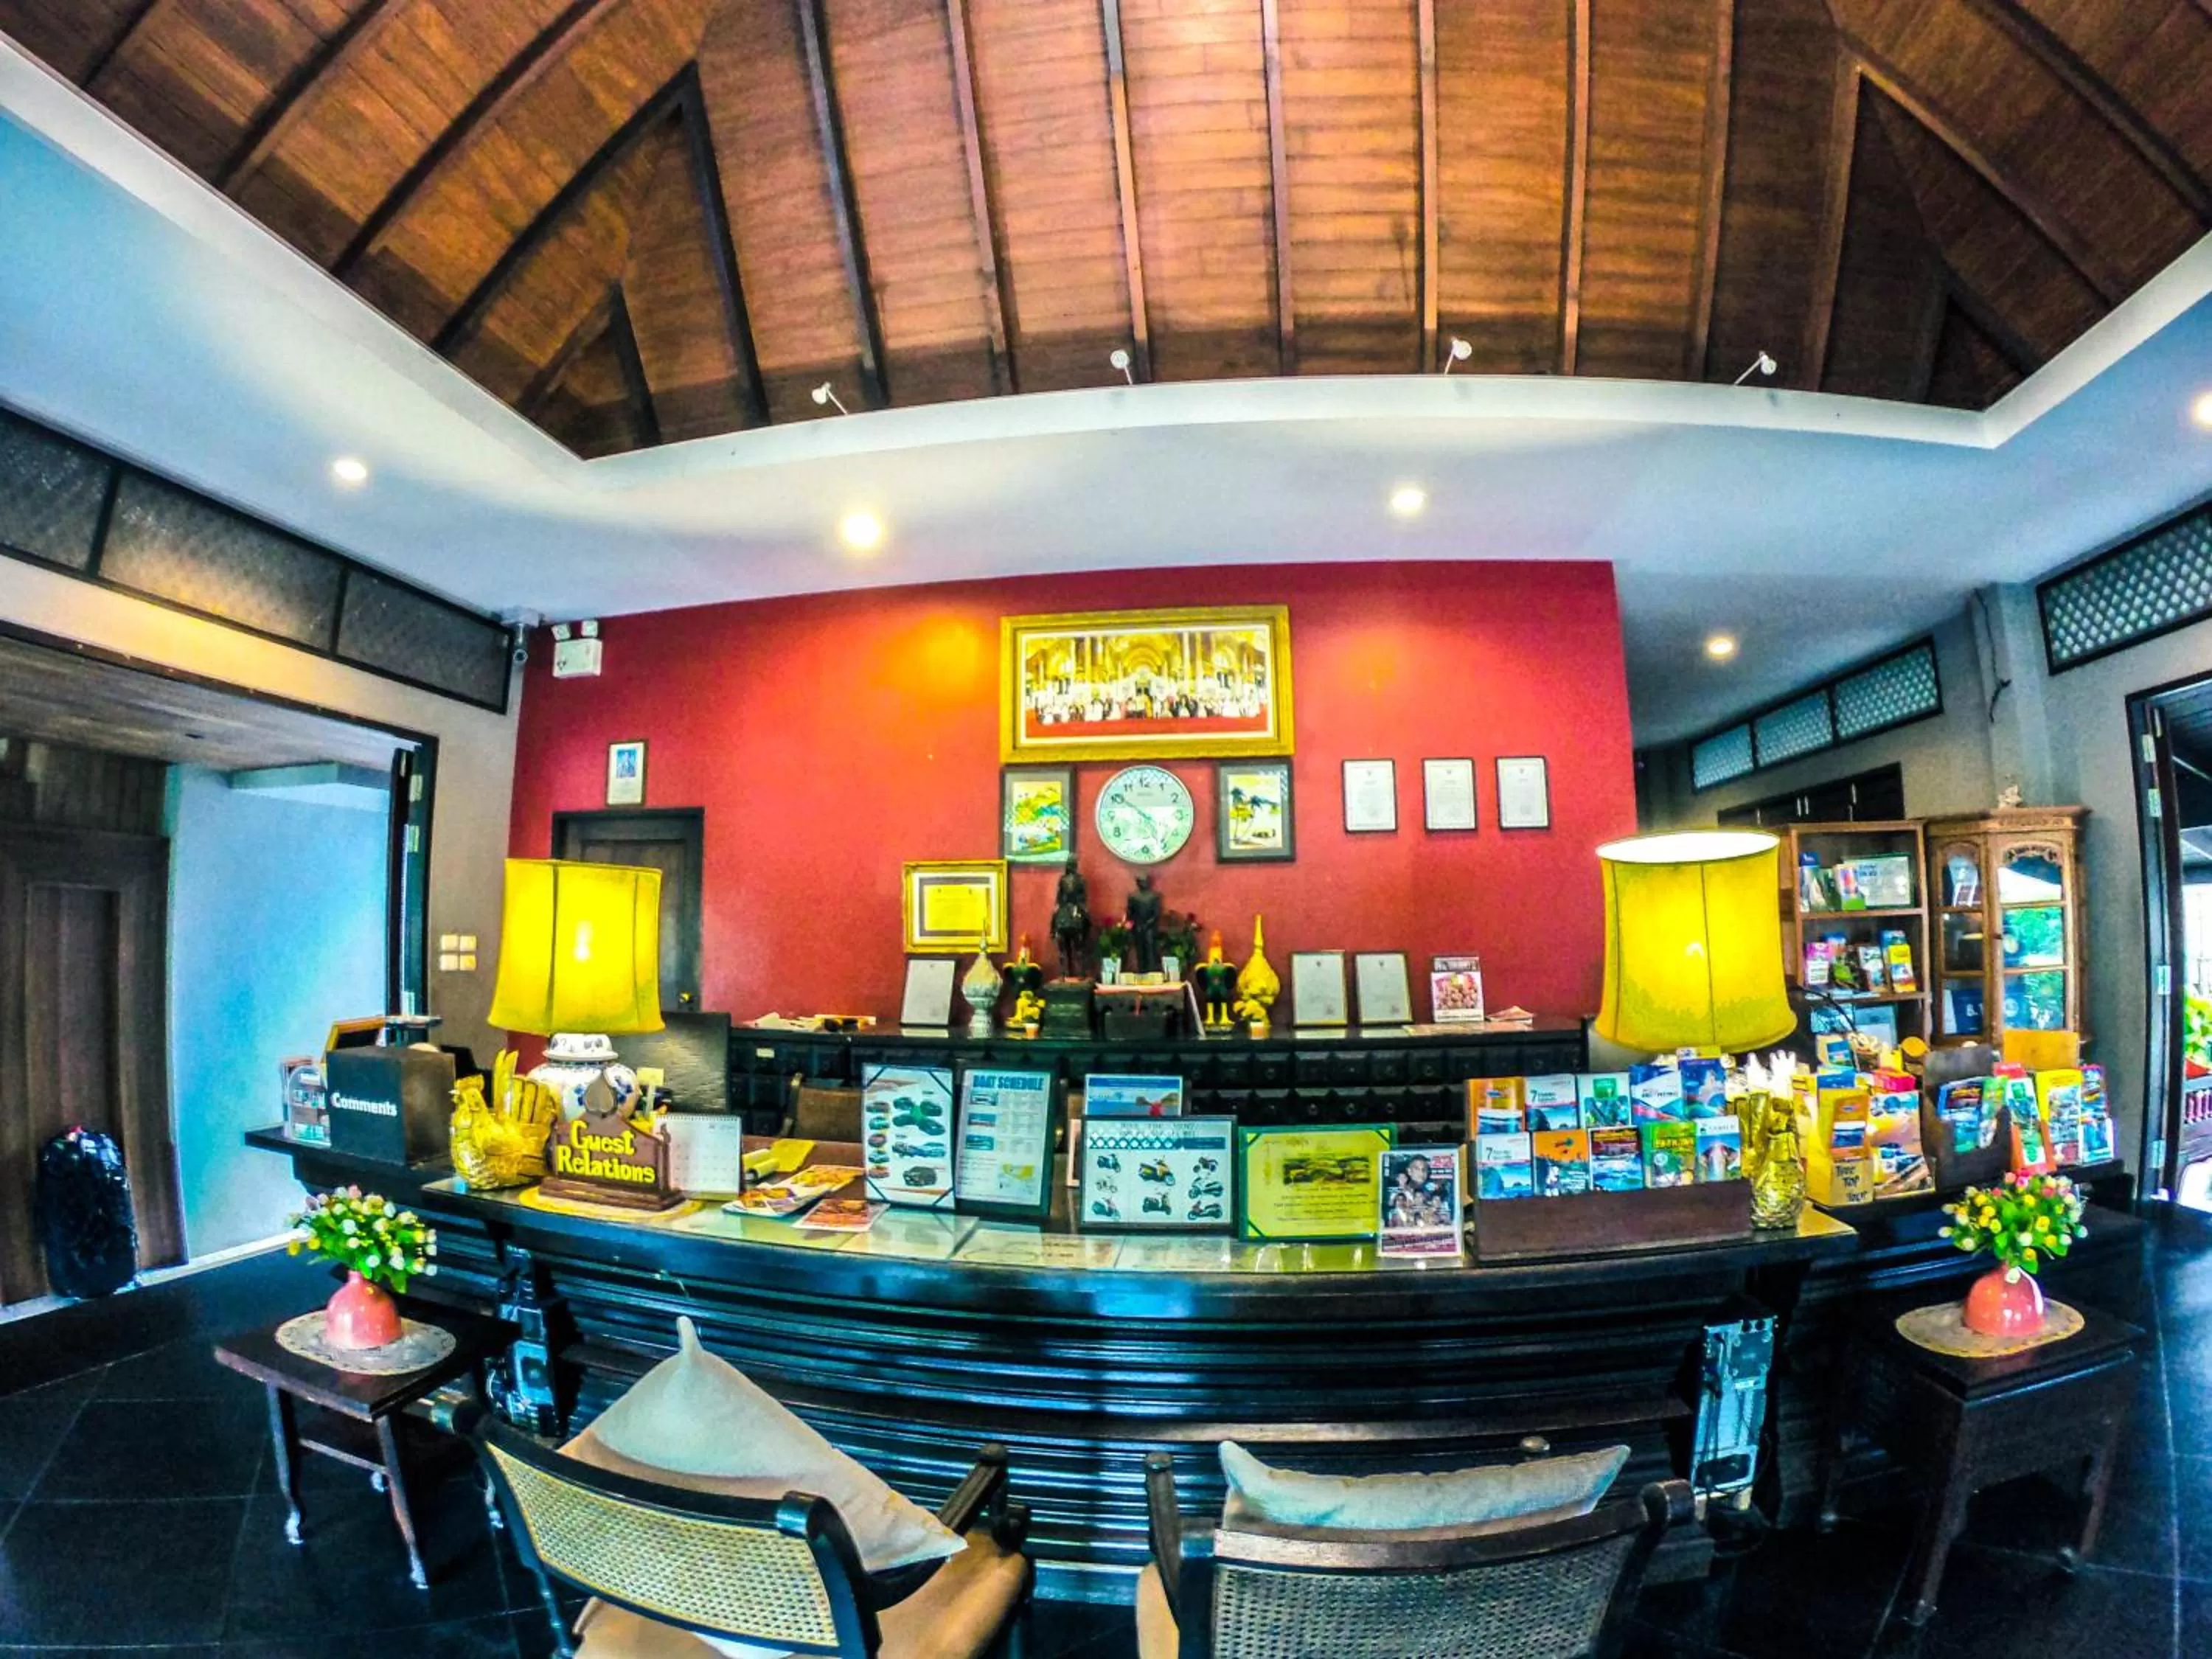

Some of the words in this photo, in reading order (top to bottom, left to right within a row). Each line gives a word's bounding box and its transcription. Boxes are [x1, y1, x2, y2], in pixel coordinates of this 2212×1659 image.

[1171, 793, 1179, 803] 2
[330, 1091, 397, 1117] Comments
[1530, 1089, 1538, 1102] 7
[570, 1120, 636, 1155] Guest
[1486, 1147, 1493, 1160] 7
[557, 1144, 655, 1183] Relations
